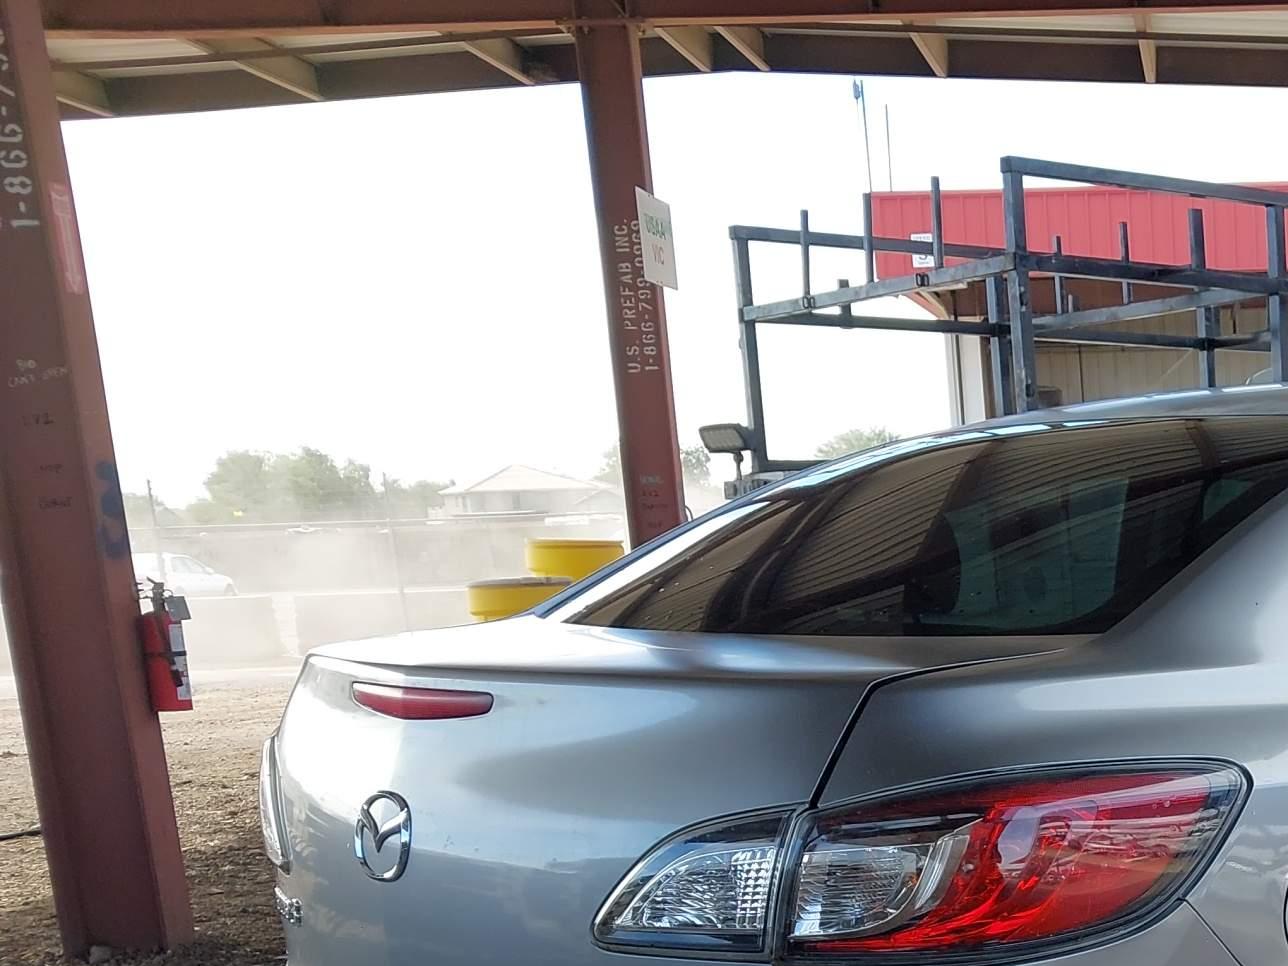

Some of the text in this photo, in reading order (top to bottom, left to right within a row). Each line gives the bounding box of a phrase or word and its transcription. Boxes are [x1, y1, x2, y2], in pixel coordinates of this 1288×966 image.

[0, 29, 40, 228] 1-866-
[614, 219, 641, 373] U.S. PREFAB INC.
